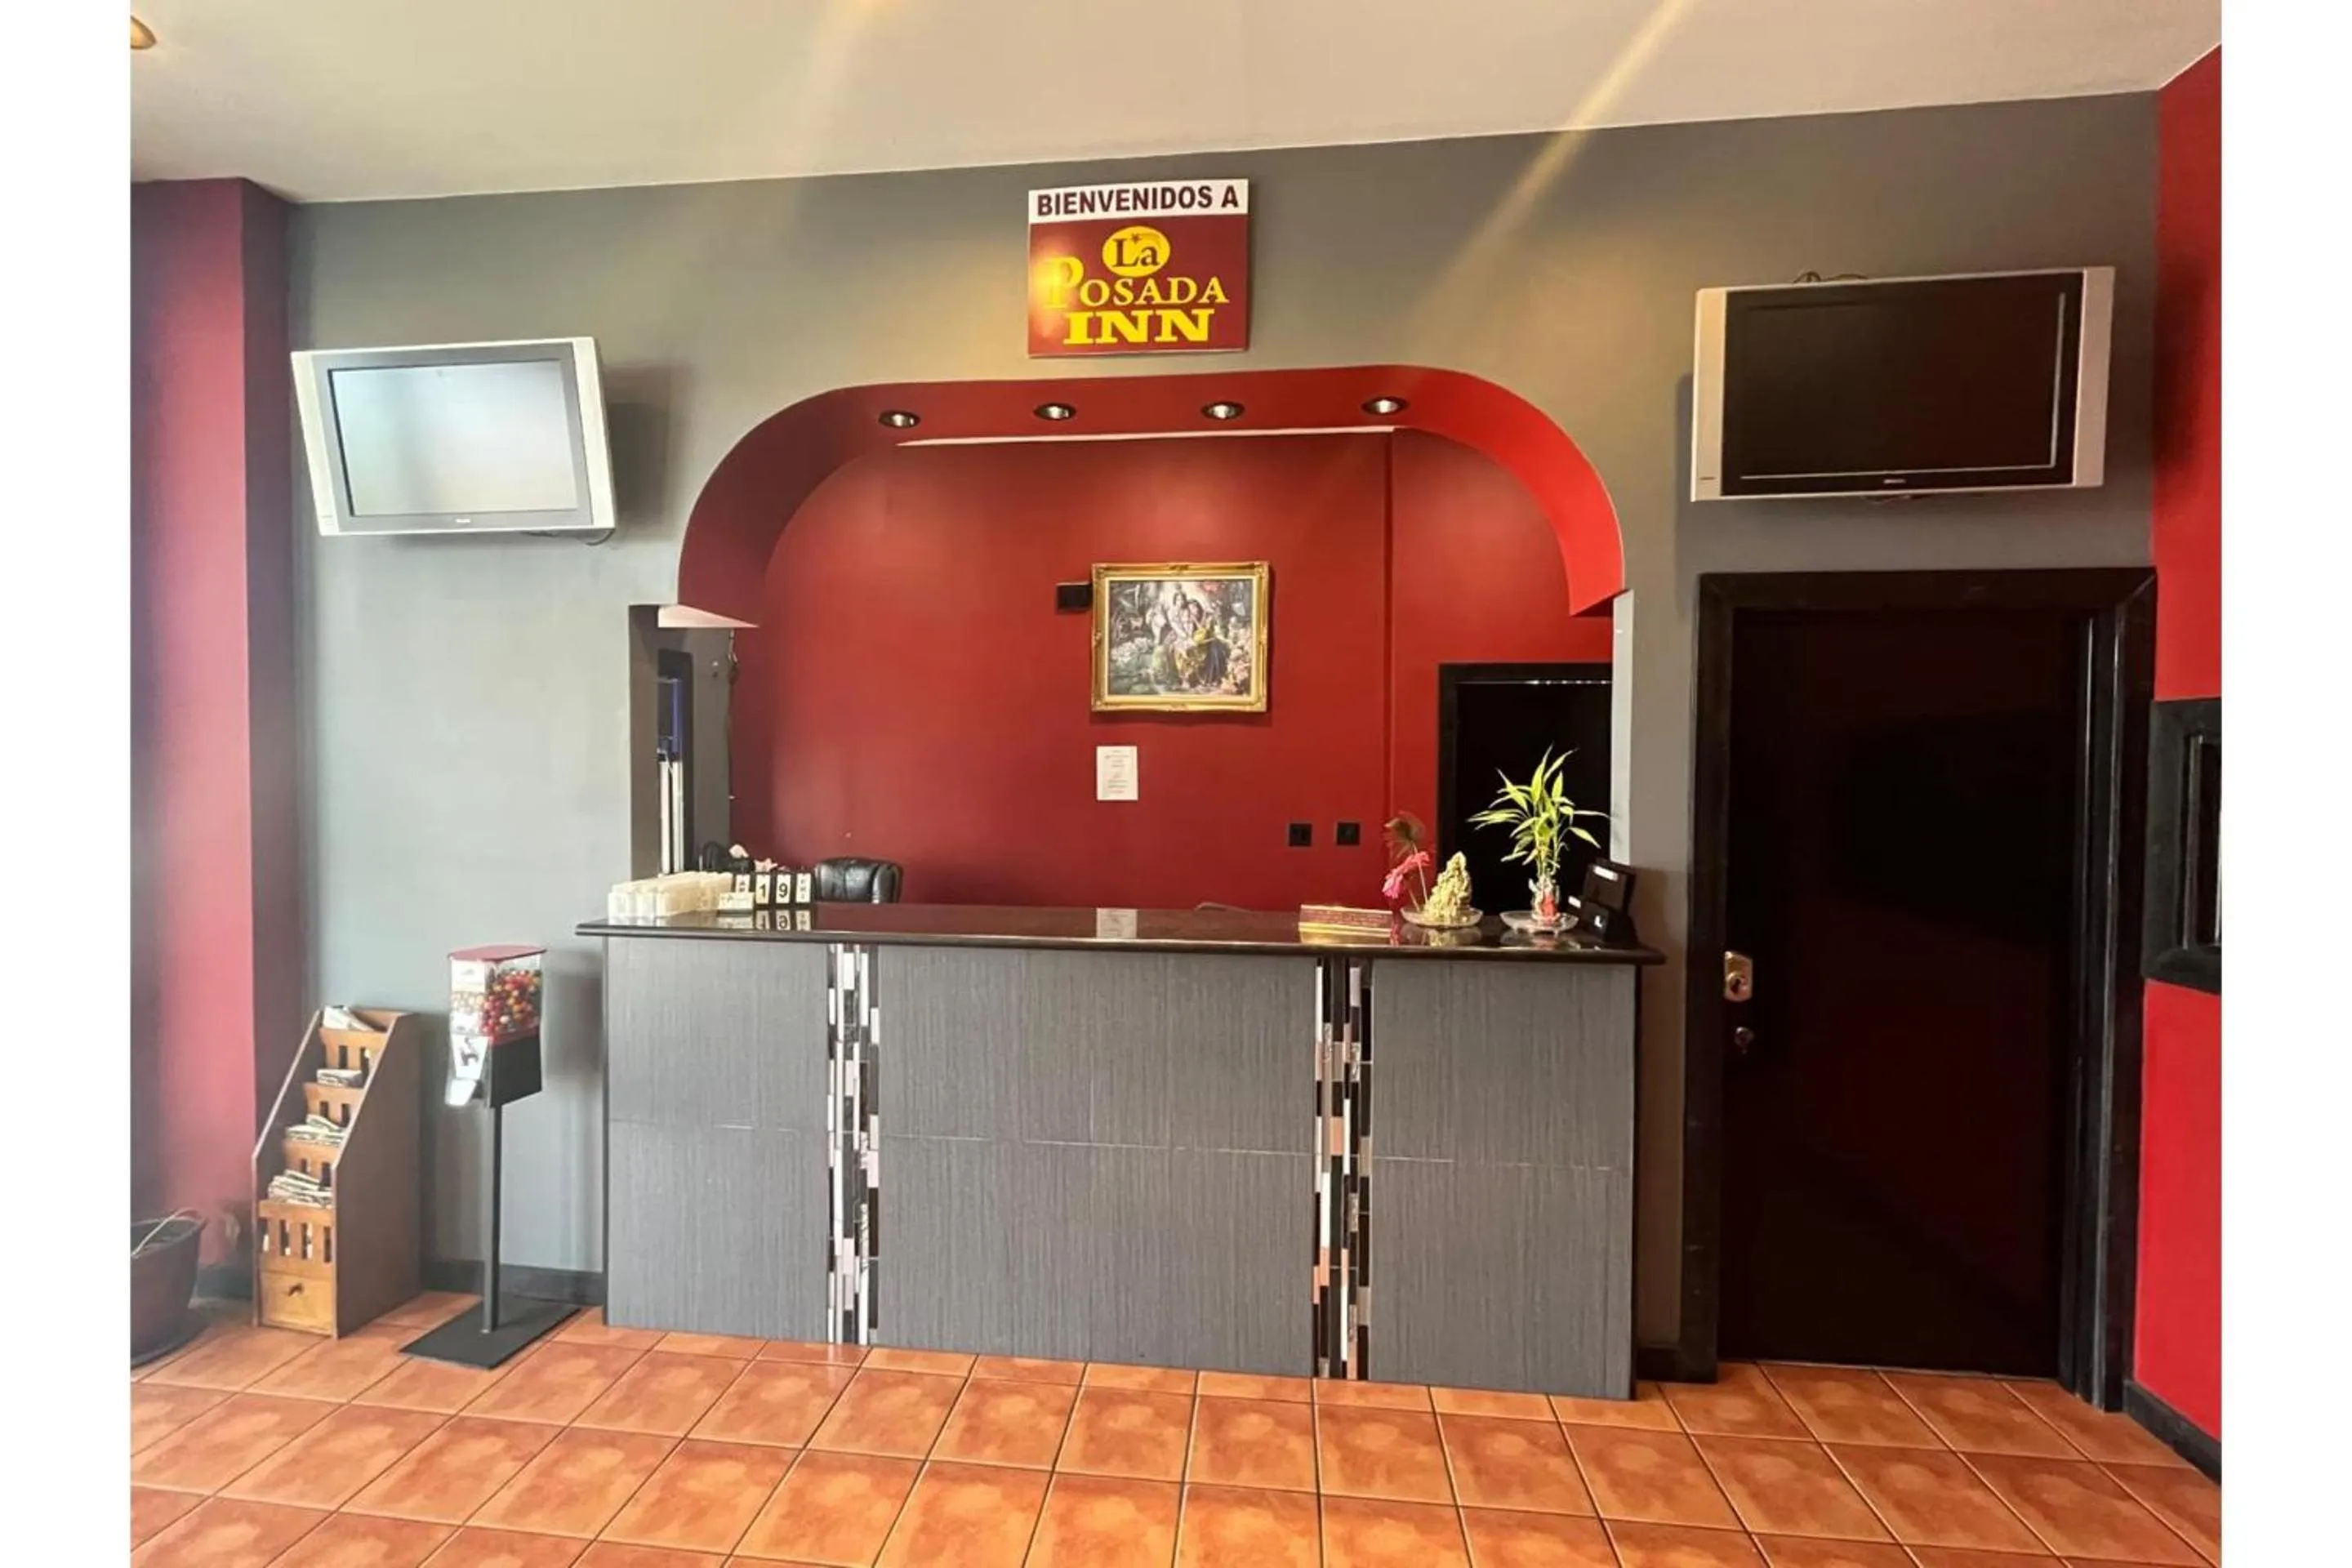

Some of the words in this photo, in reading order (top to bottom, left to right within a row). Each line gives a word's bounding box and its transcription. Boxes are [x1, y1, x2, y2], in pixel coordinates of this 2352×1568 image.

[1036, 185, 1213, 216] BIENVENIDOS
[1221, 185, 1239, 208] A
[1112, 238, 1160, 268] La
[1044, 256, 1230, 309] POSADA
[1062, 308, 1215, 345] INN
